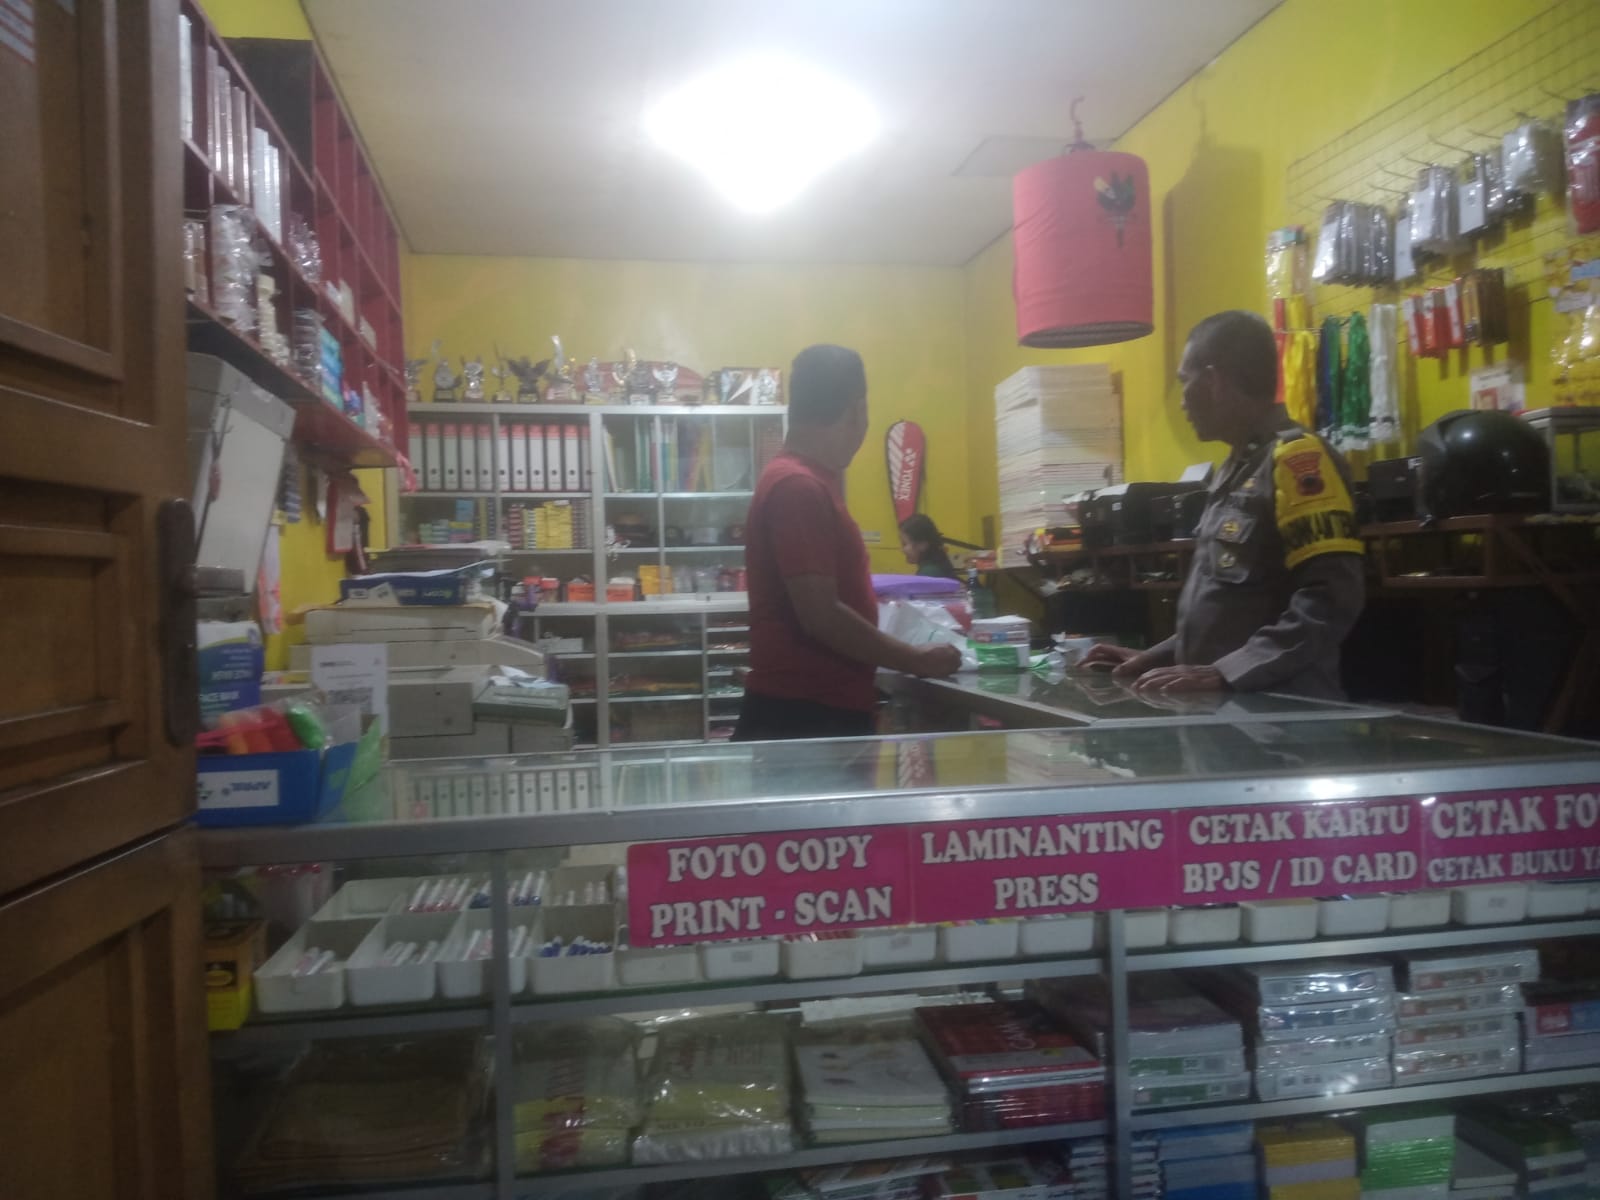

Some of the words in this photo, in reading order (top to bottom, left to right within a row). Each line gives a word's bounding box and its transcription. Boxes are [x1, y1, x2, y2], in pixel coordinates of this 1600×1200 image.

[1189, 811, 1296, 846] CETAK
[1303, 805, 1410, 839] KARTU
[1431, 796, 1547, 839] CETAK
[1555, 792, 1600, 831] FO
[667, 842, 766, 882] FOTO
[776, 834, 873, 874] COPY
[921, 819, 1165, 864] LAMINANTING
[1183, 860, 1261, 893] BPJS
[1289, 856, 1325, 887] ID
[1332, 851, 1418, 884] CARD
[1427, 854, 1505, 882] CETAK
[1510, 848, 1575, 876] BUKU
[650, 896, 766, 938] PRINT
[795, 886, 893, 926] SCAN
[993, 872, 1099, 910] PRESS
